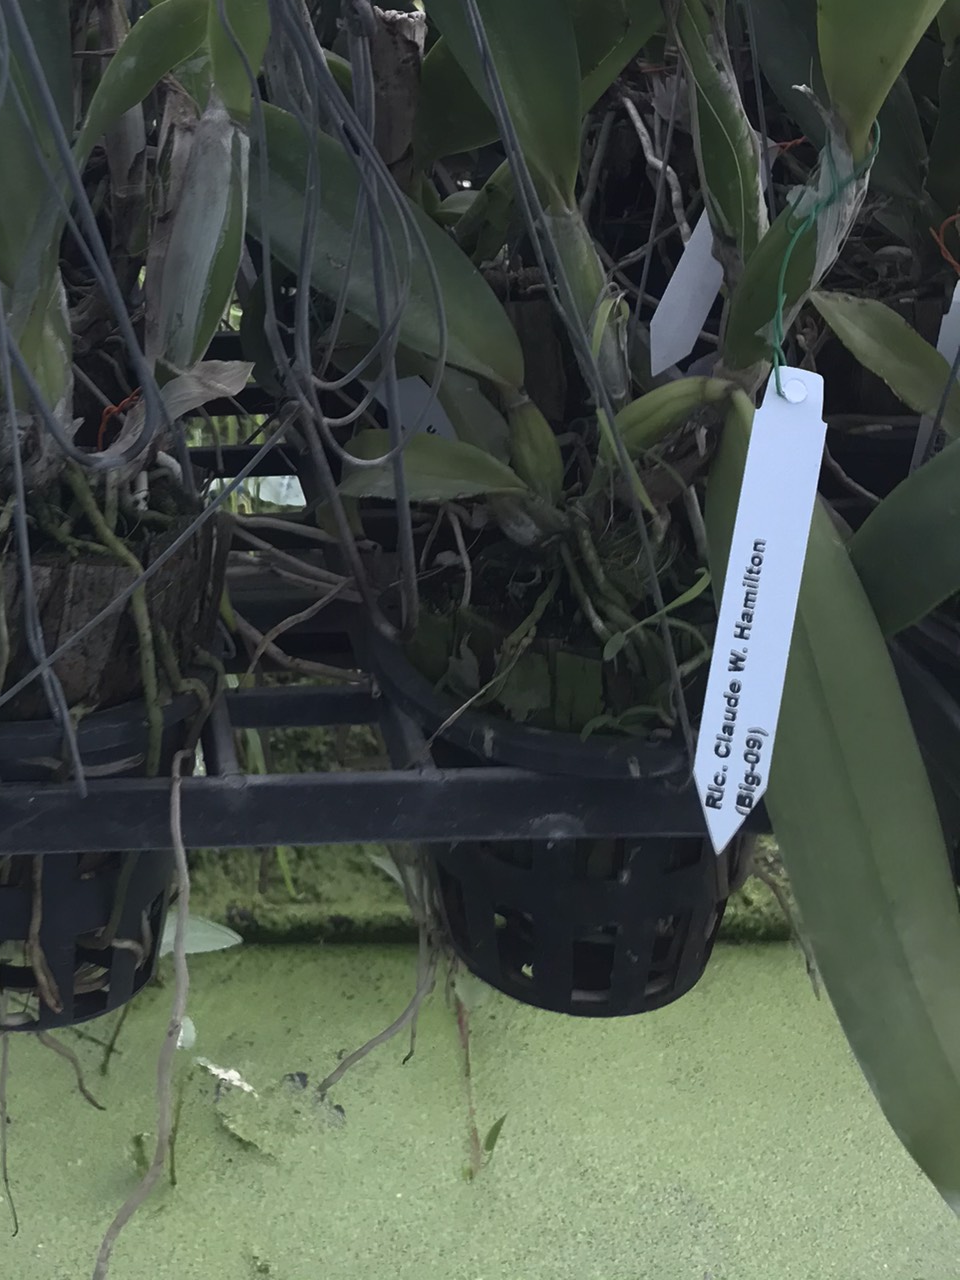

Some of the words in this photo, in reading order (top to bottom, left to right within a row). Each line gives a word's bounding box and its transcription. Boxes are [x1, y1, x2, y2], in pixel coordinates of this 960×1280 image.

[733, 538, 767, 640] Hamilton
[728, 647, 748, 672] W.
[714, 678, 742, 758] Claude
[735, 726, 769, 816] (Big-09)
